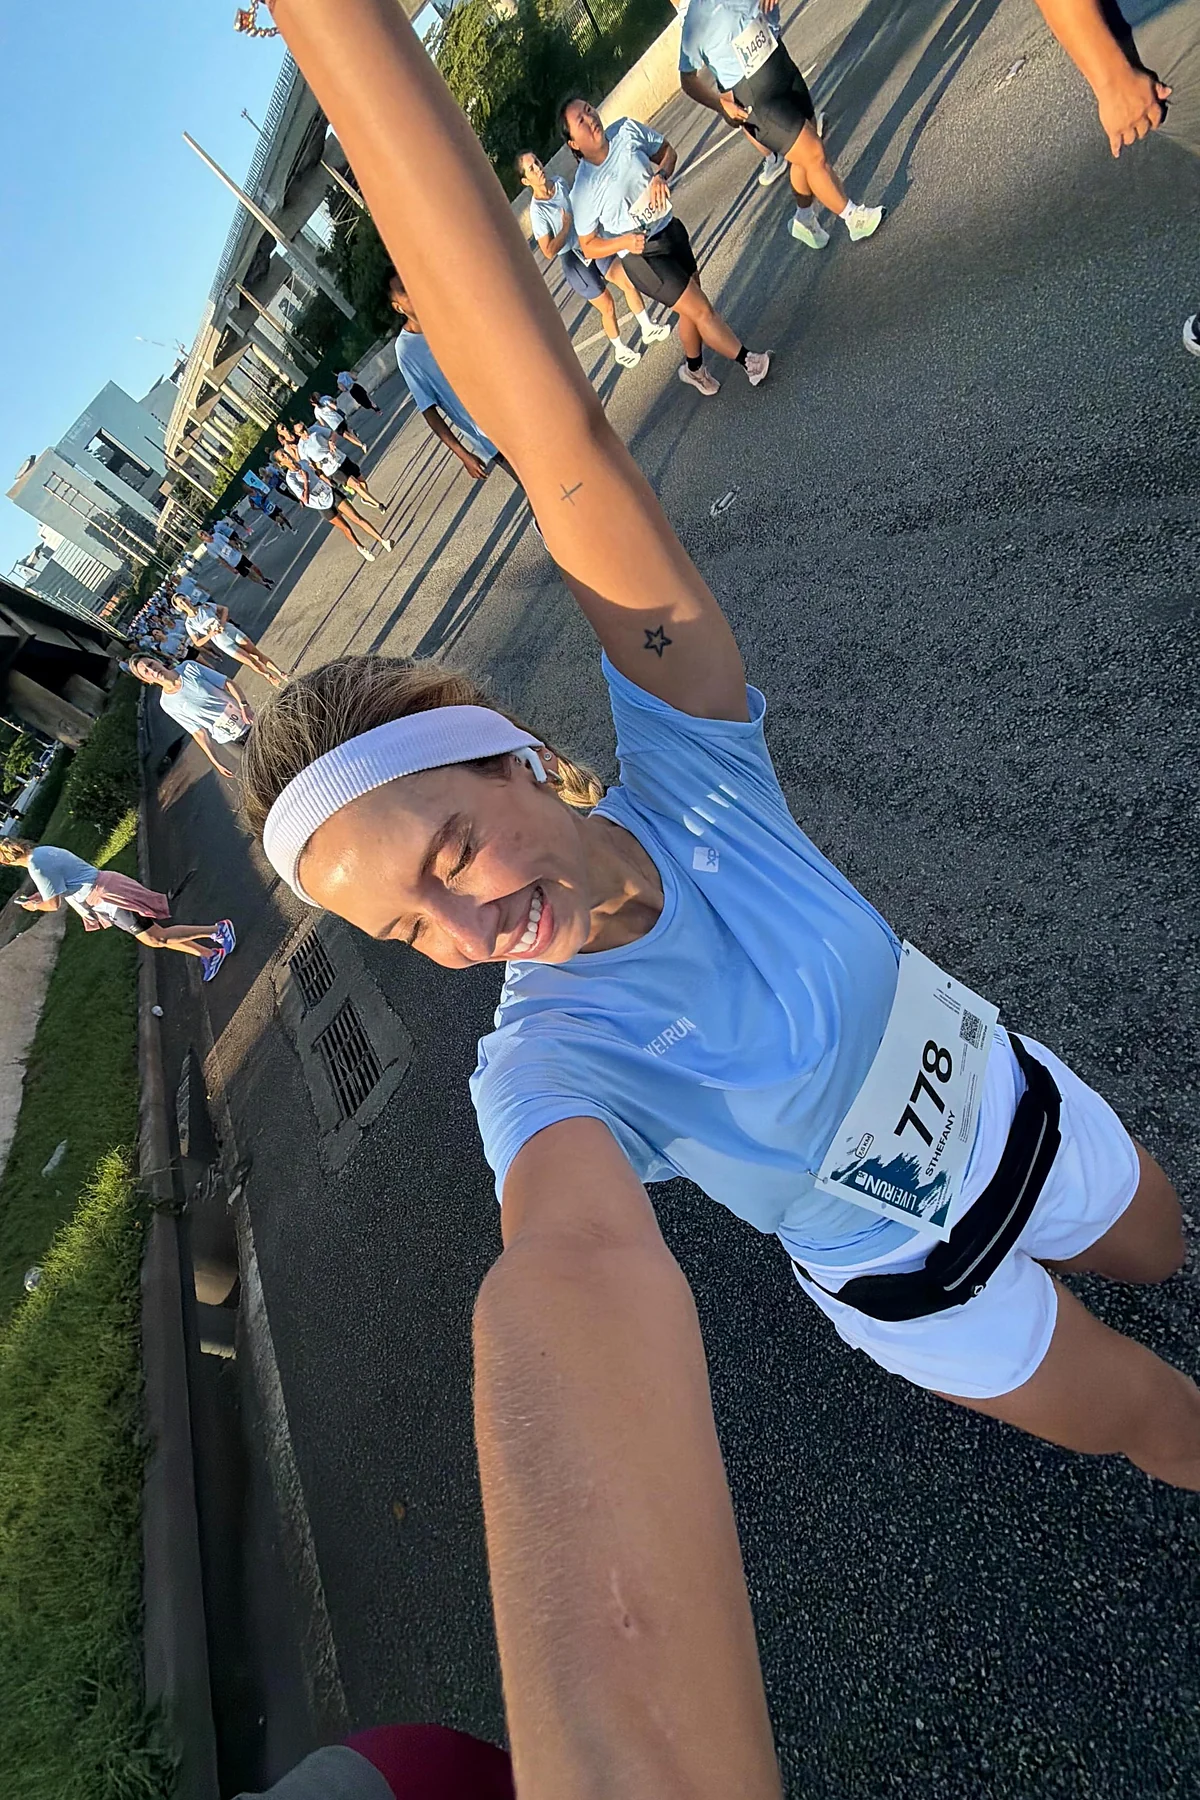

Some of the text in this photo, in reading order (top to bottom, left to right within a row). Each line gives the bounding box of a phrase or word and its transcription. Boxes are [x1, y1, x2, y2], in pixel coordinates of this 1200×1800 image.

[746, 30, 767, 58] 1463
[641, 200, 664, 222] 139
[894, 1039, 953, 1148] 778
[925, 1110, 956, 1177] STHEFANY
[864, 1175, 917, 1210] LIVE!RUN
